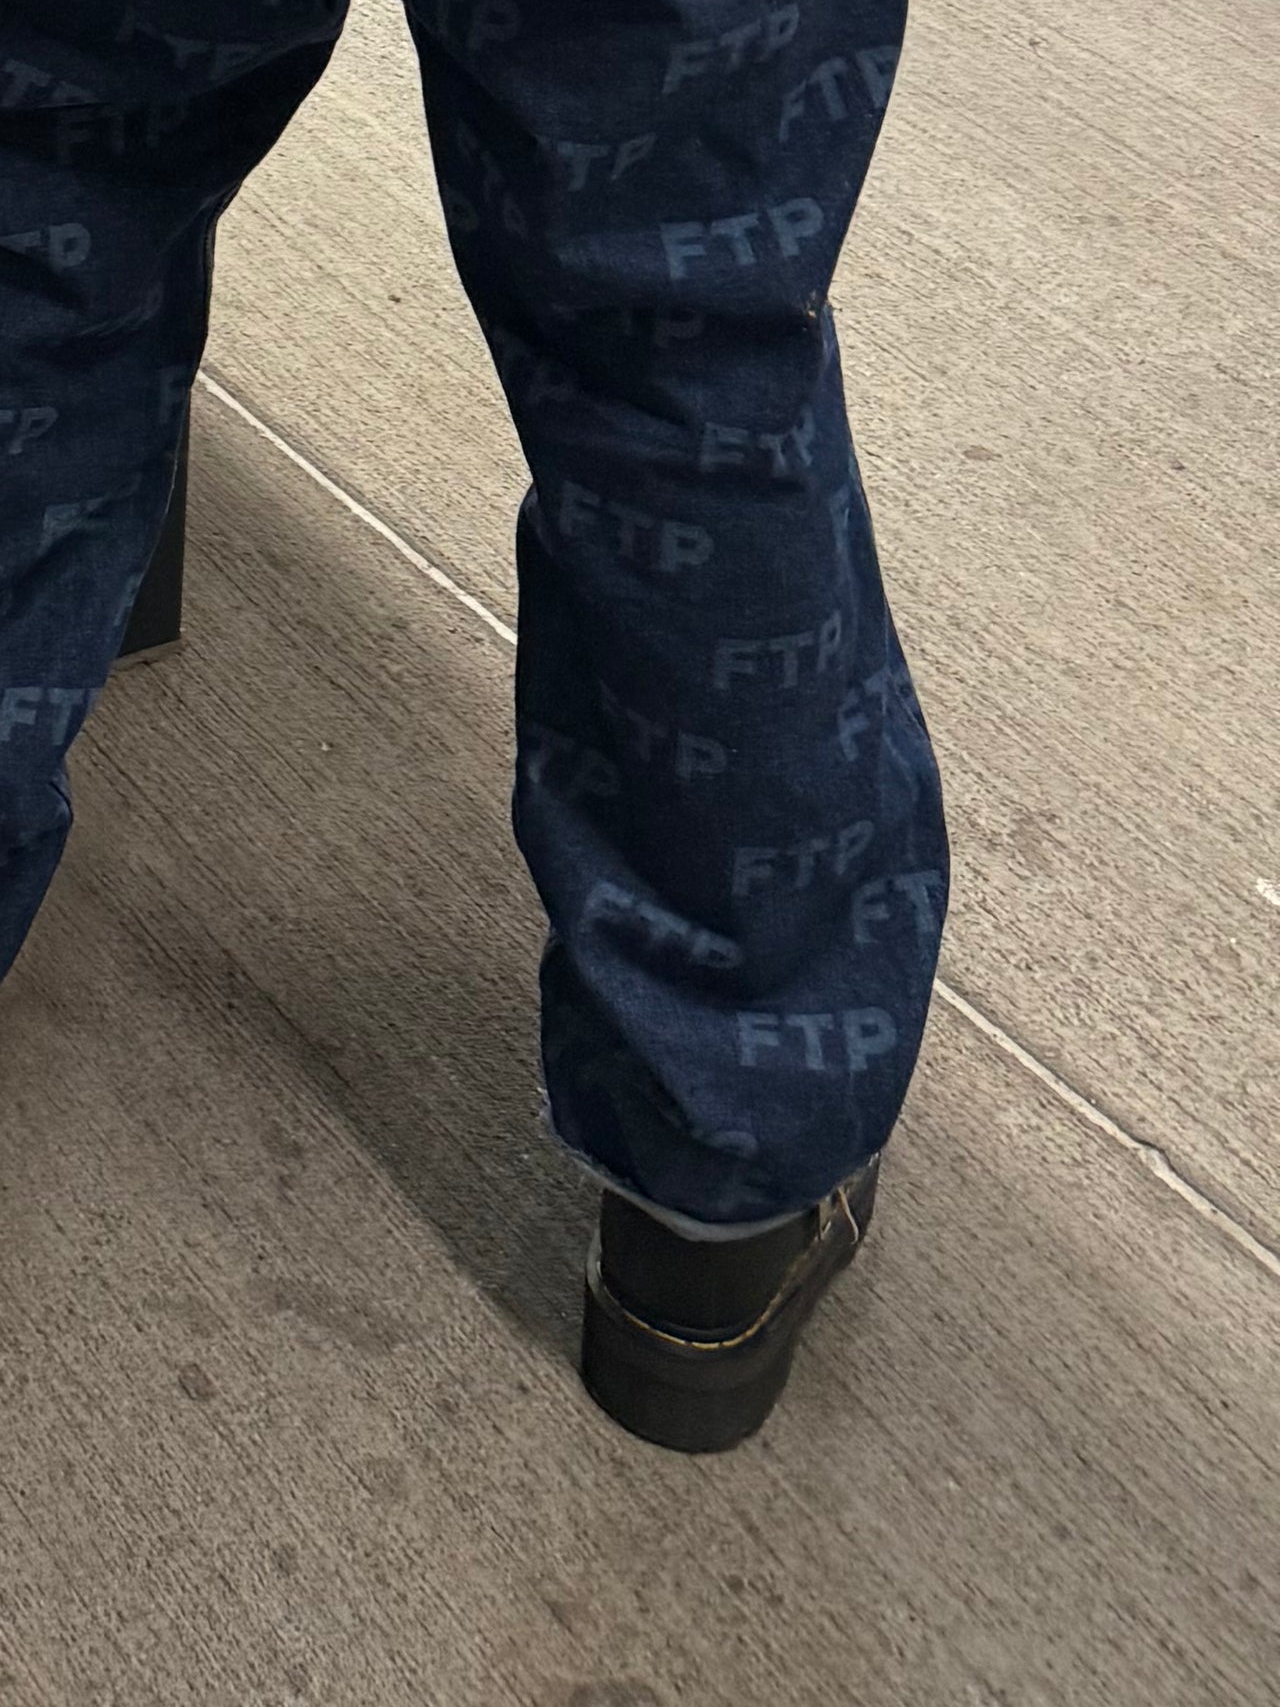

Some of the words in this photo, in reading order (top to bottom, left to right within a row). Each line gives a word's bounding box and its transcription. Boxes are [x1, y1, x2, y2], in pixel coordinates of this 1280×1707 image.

[661, 3, 800, 94] FTP
[659, 196, 826, 282] FTP
[559, 479, 714, 574] FTP
[712, 609, 843, 691] FTP
[730, 819, 877, 899] FTP
[736, 1004, 900, 1075] FTP
